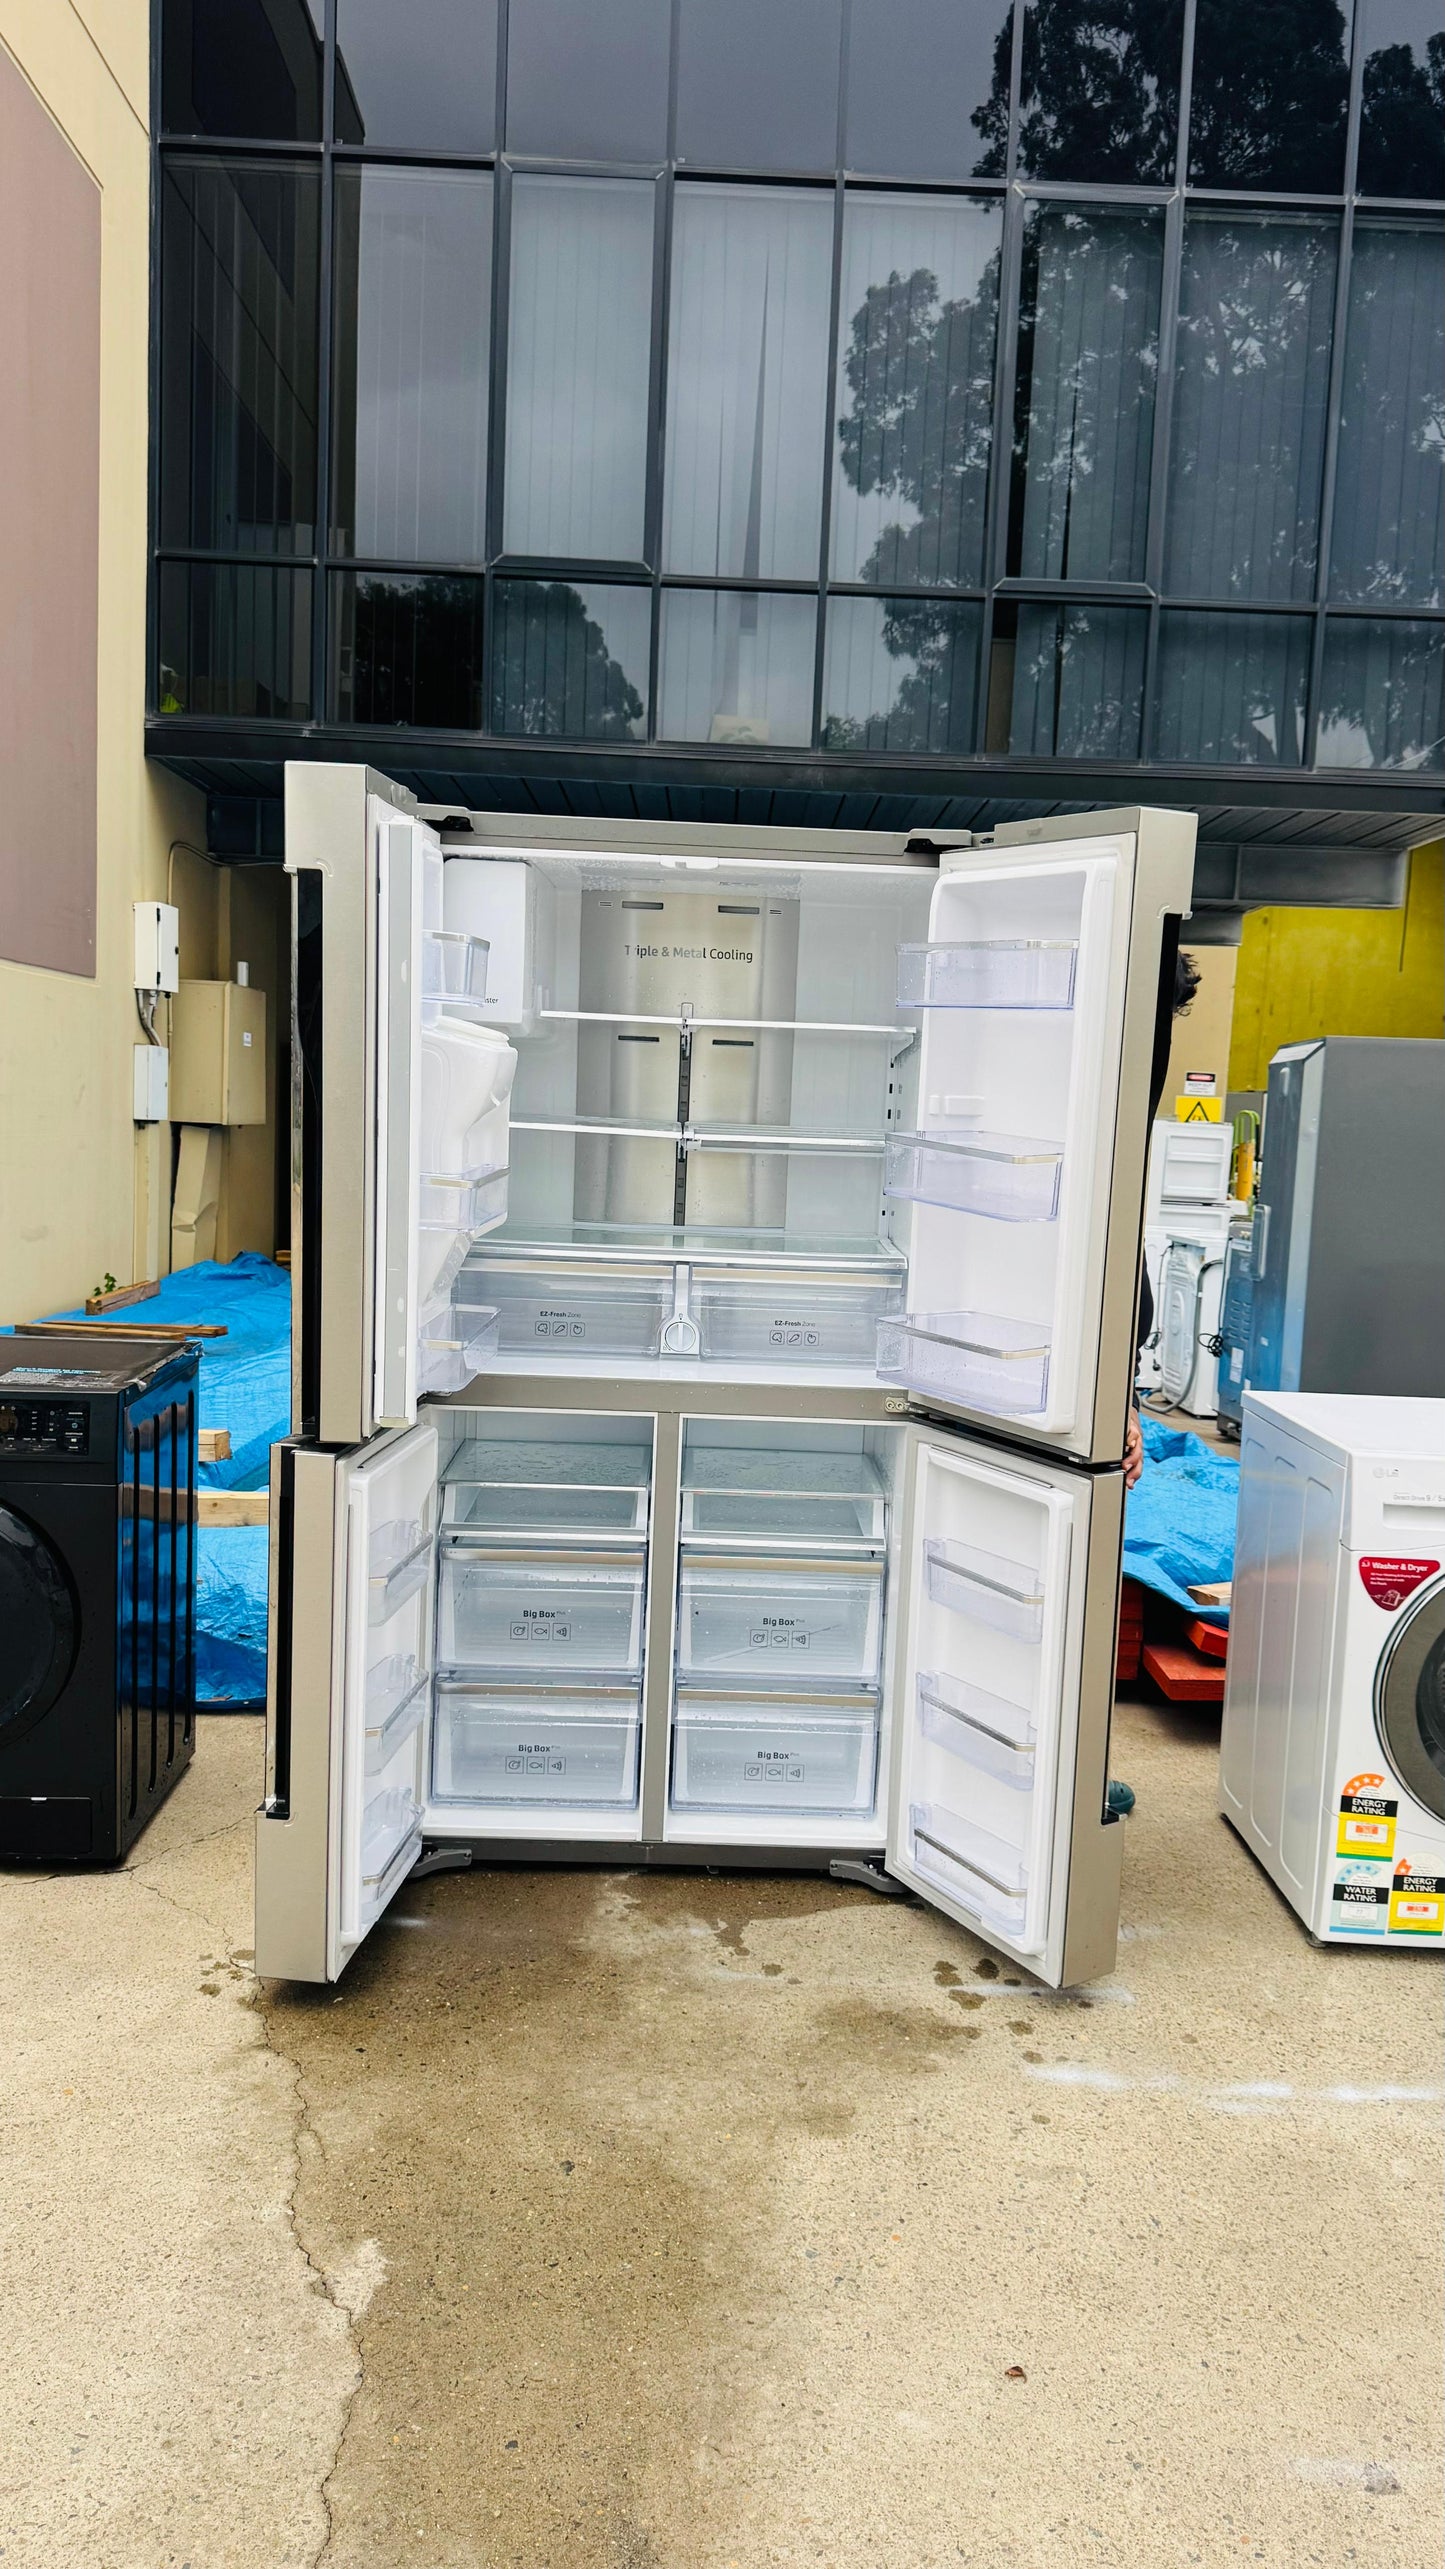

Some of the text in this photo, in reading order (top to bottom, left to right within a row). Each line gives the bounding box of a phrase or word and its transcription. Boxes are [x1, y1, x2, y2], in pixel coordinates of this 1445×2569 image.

[624, 945, 753, 964] Tiple & Metal Cooling
[1372, 1562, 1429, 1573] Washer & Dryer
[523, 1610, 538, 1619] Big
[539, 1610, 556, 1618] Box
[763, 1617, 777, 1627] Big
[778, 1618, 795, 1626] Box
[518, 1744, 533, 1753] Big
[757, 1751, 772, 1760] Big
[773, 1751, 790, 1760] Box
[1352, 1798, 1387, 1808] ENERGY
[1351, 1806, 1386, 1816] RATING
[1403, 1876, 1438, 1886] ENERGY
[1345, 1885, 1377, 1895] WATER
[1402, 1884, 1436, 1893] RATING
[1343, 1893, 1377, 1903] RATING
